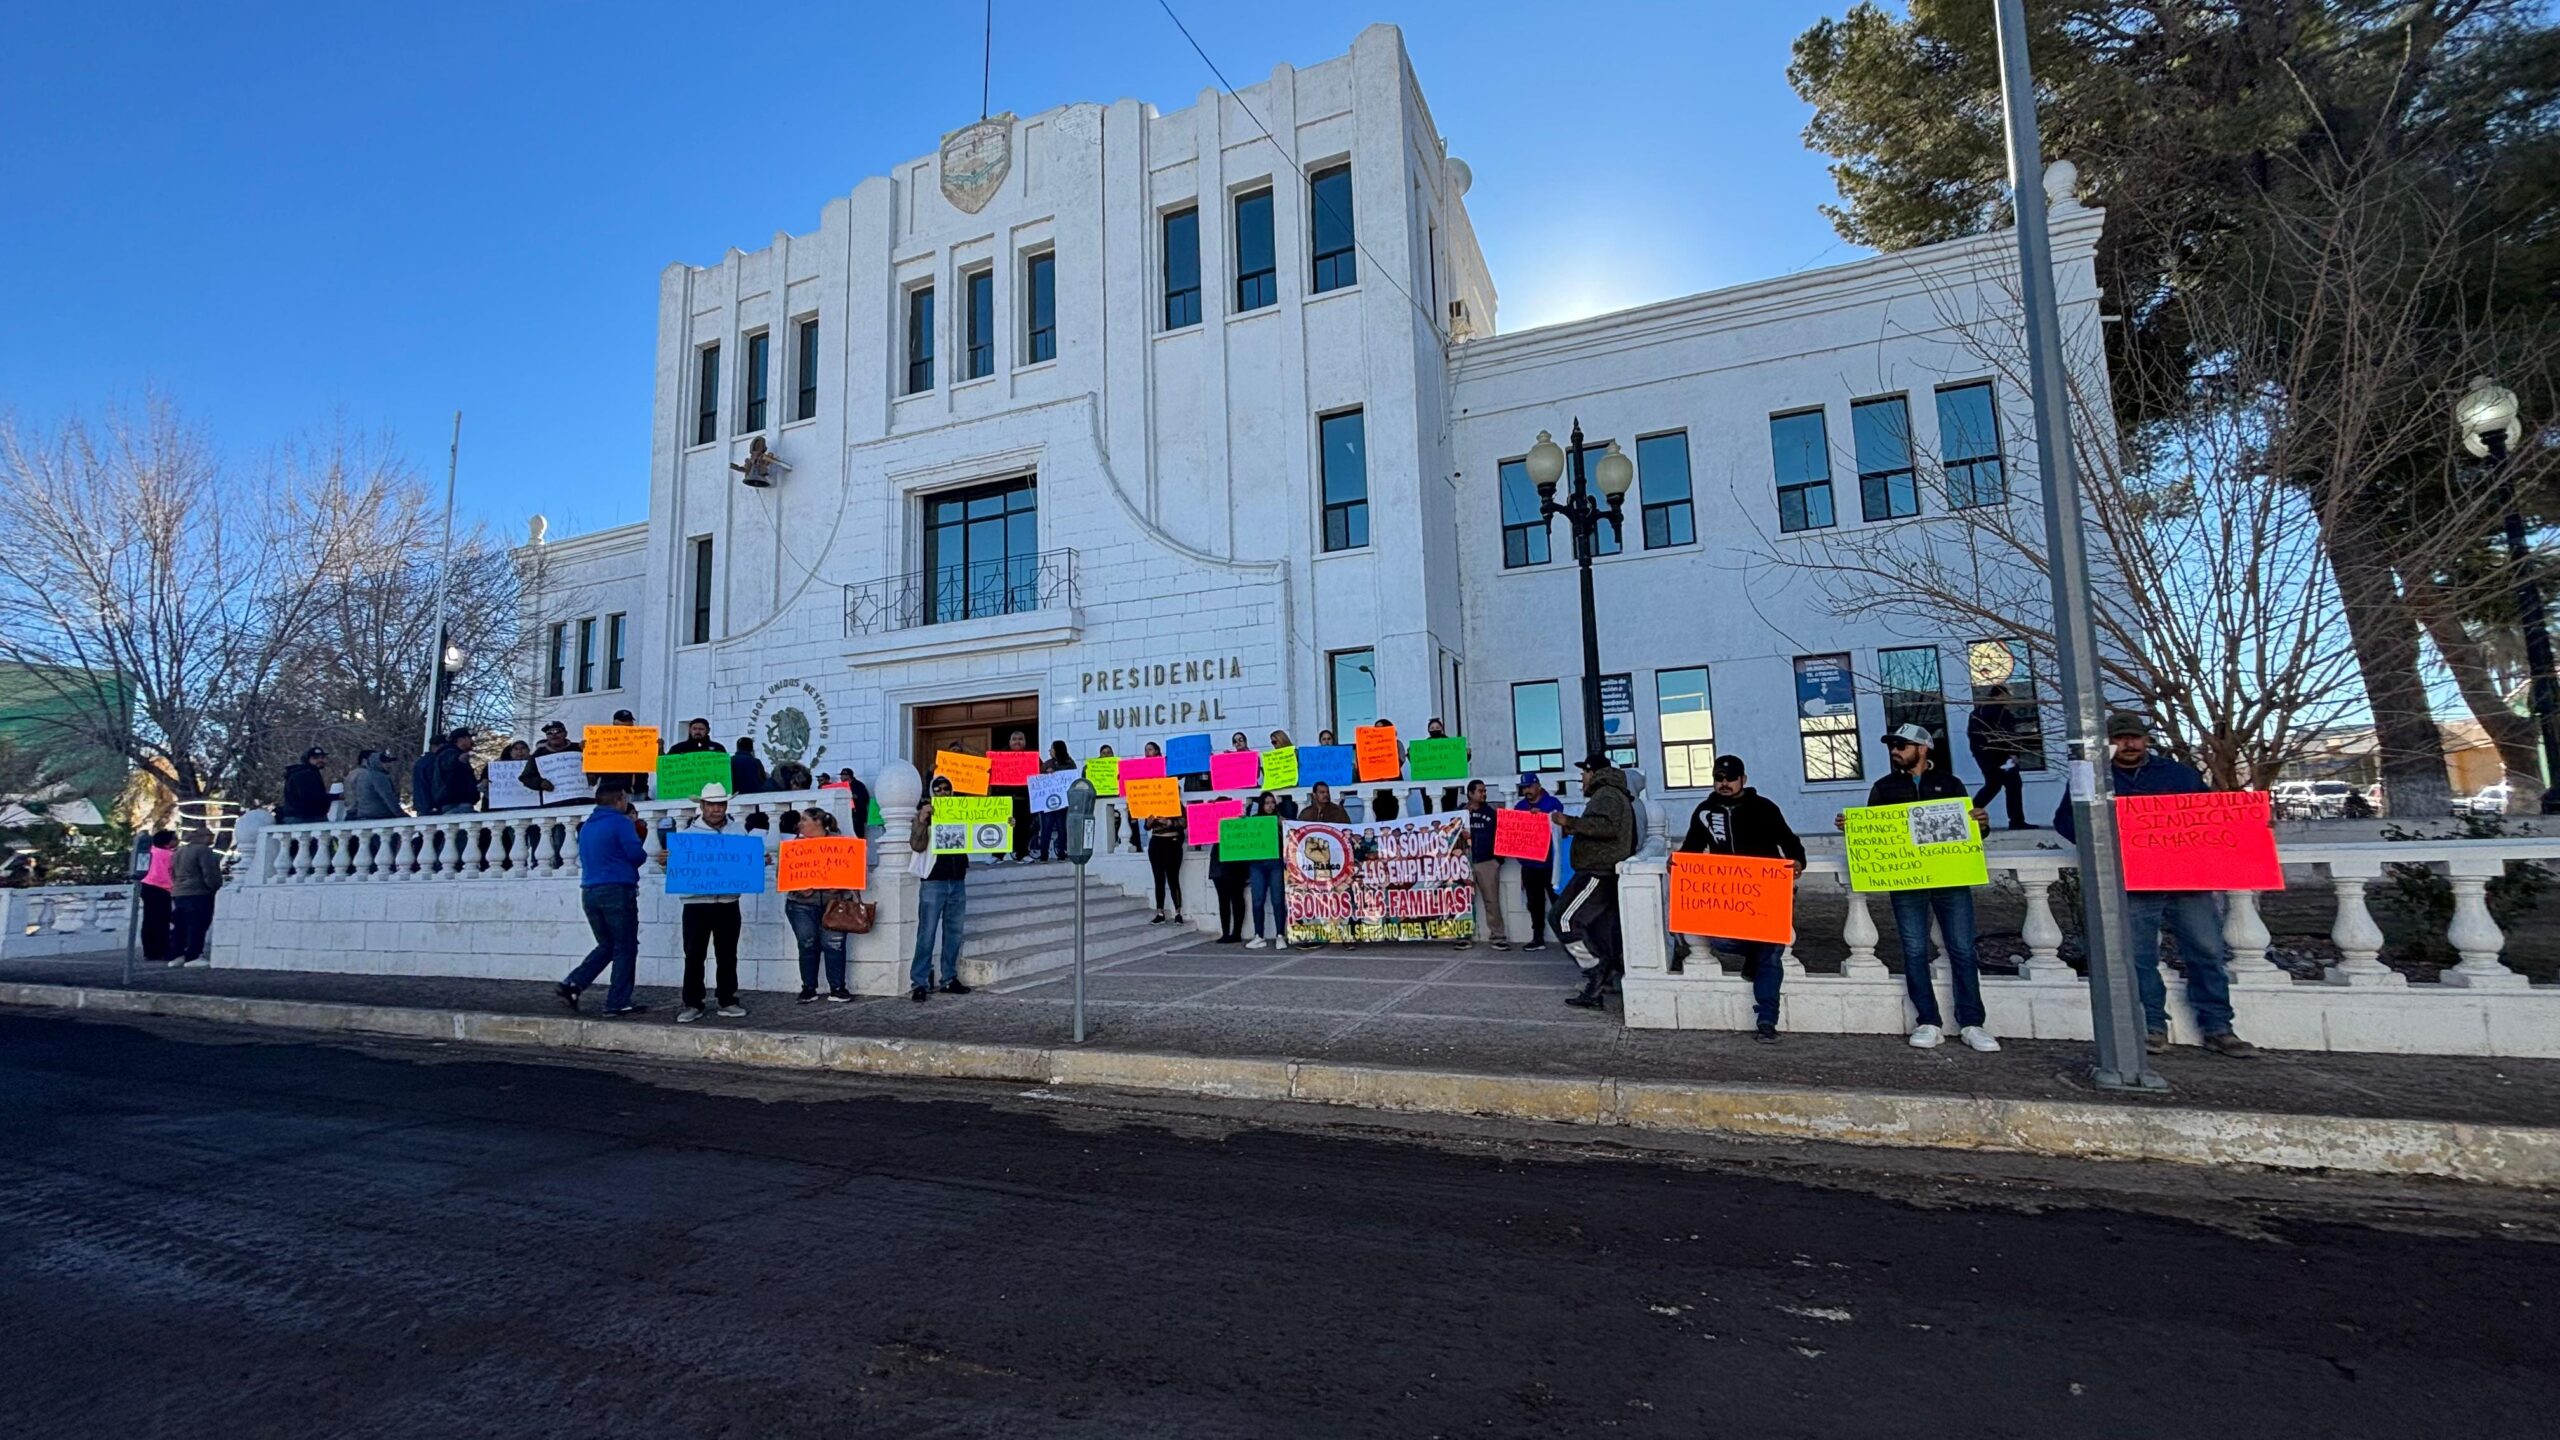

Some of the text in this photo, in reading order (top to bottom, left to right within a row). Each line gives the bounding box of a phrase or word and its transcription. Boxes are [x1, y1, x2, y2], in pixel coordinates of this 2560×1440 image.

[1081, 656, 1241, 693] PRESIDENCIA
[768, 678, 800, 694] UNIDOS
[803, 683, 829, 739] MEXICANOS
[1097, 698, 1226, 731] MUNICIPAL
[934, 797, 1008, 808] APOYO TOTAL
[2126, 796, 2138, 814] A
[2143, 796, 2166, 812] LA
[946, 808, 1010, 820] SINDICATO
[2136, 806, 2265, 830] SINDICATO
[1711, 812, 1727, 841] NIKE
[1845, 822, 1898, 834] HUMANOS
[1378, 832, 1448, 859] NO SOMOS
[1847, 835, 1906, 846] LABORALES
[2131, 829, 2239, 849] CAMARGO
[819, 844, 843, 854] VAN
[847, 845, 856, 855] A
[1849, 848, 1870, 861] NO
[1875, 849, 1897, 860] SON
[1899, 848, 1915, 858] UN
[1362, 855, 1470, 885] 116 EMPLEADOS
[1680, 862, 1752, 878] VIOLENTAS
[1851, 860, 1922, 874] UN DERECHO
[687, 880, 750, 890] SINDICATO
[1680, 878, 1762, 897] DERECHOS
[1287, 886, 1473, 925] ¡SOMOS 116 FAMILIAS!
[1400, 922, 1425, 938] FIDEL
